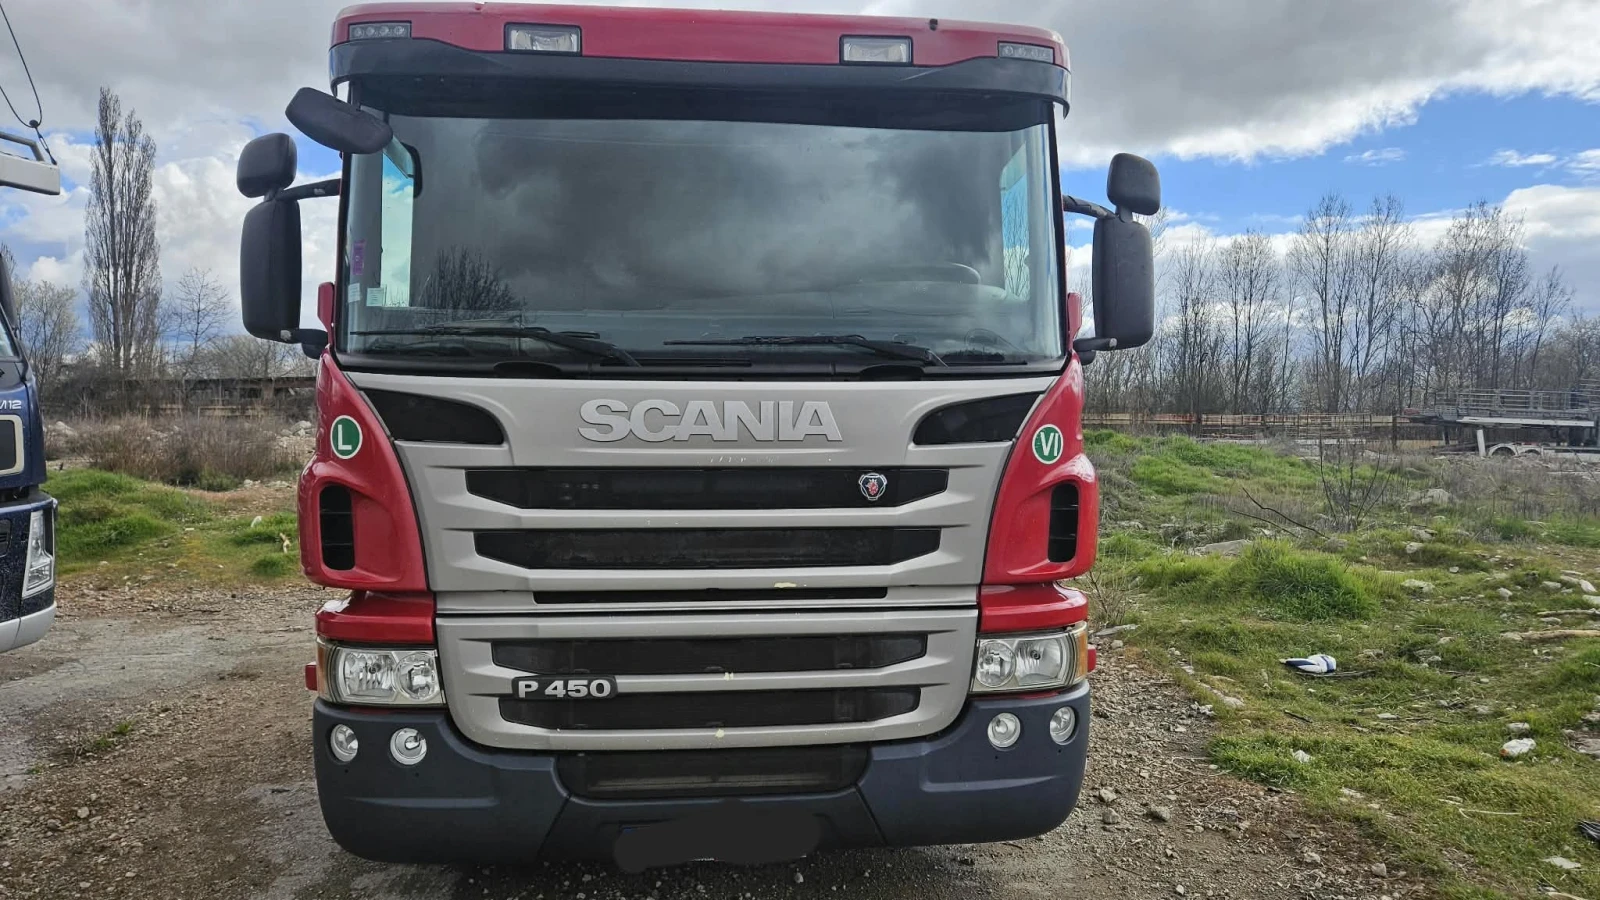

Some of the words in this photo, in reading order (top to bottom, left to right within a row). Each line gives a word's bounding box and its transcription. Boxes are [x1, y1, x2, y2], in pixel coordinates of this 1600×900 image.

[578, 399, 843, 442] SCANIA
[337, 424, 353, 451] L
[1040, 431, 1059, 457] VI
[518, 680, 539, 699] P
[544, 679, 611, 698] 450
